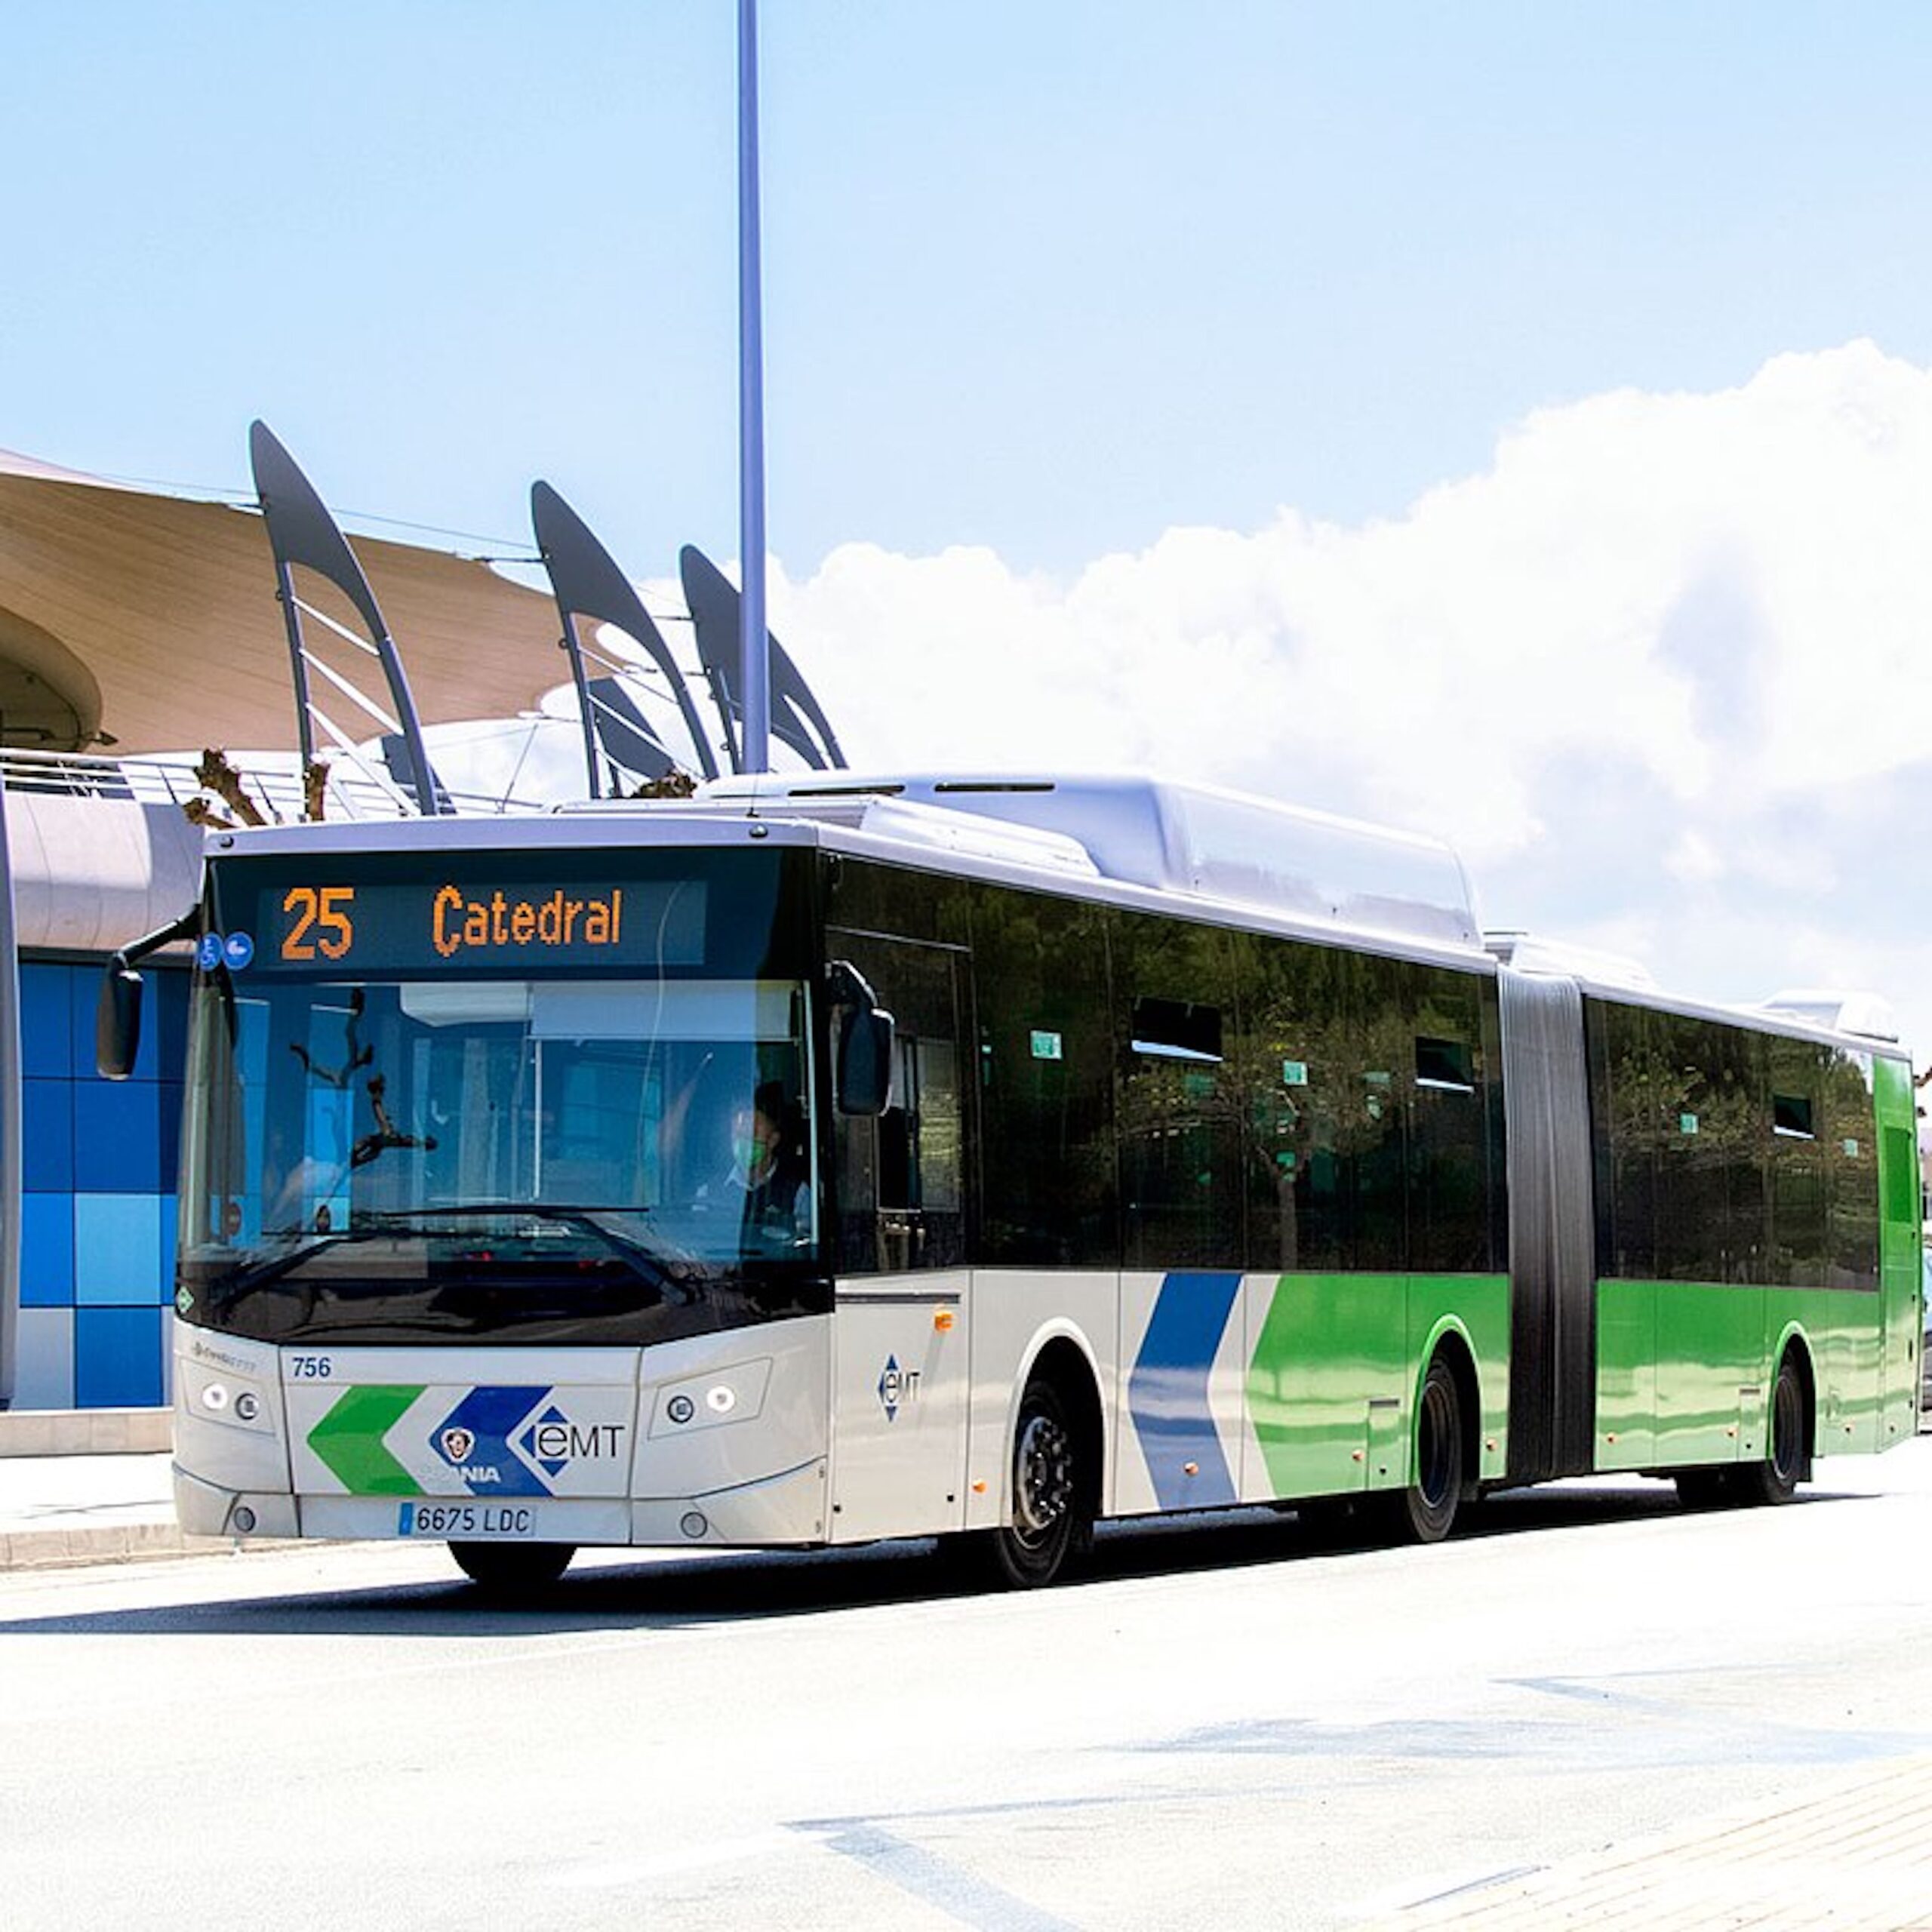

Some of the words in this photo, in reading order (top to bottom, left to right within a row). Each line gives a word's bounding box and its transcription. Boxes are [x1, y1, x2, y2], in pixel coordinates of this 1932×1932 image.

[281, 887, 355, 960] 25
[432, 885, 622, 958] Catedral
[292, 1357, 331, 1377] 756
[417, 1508, 474, 1531] 6675
[484, 1509, 529, 1532] LDC
